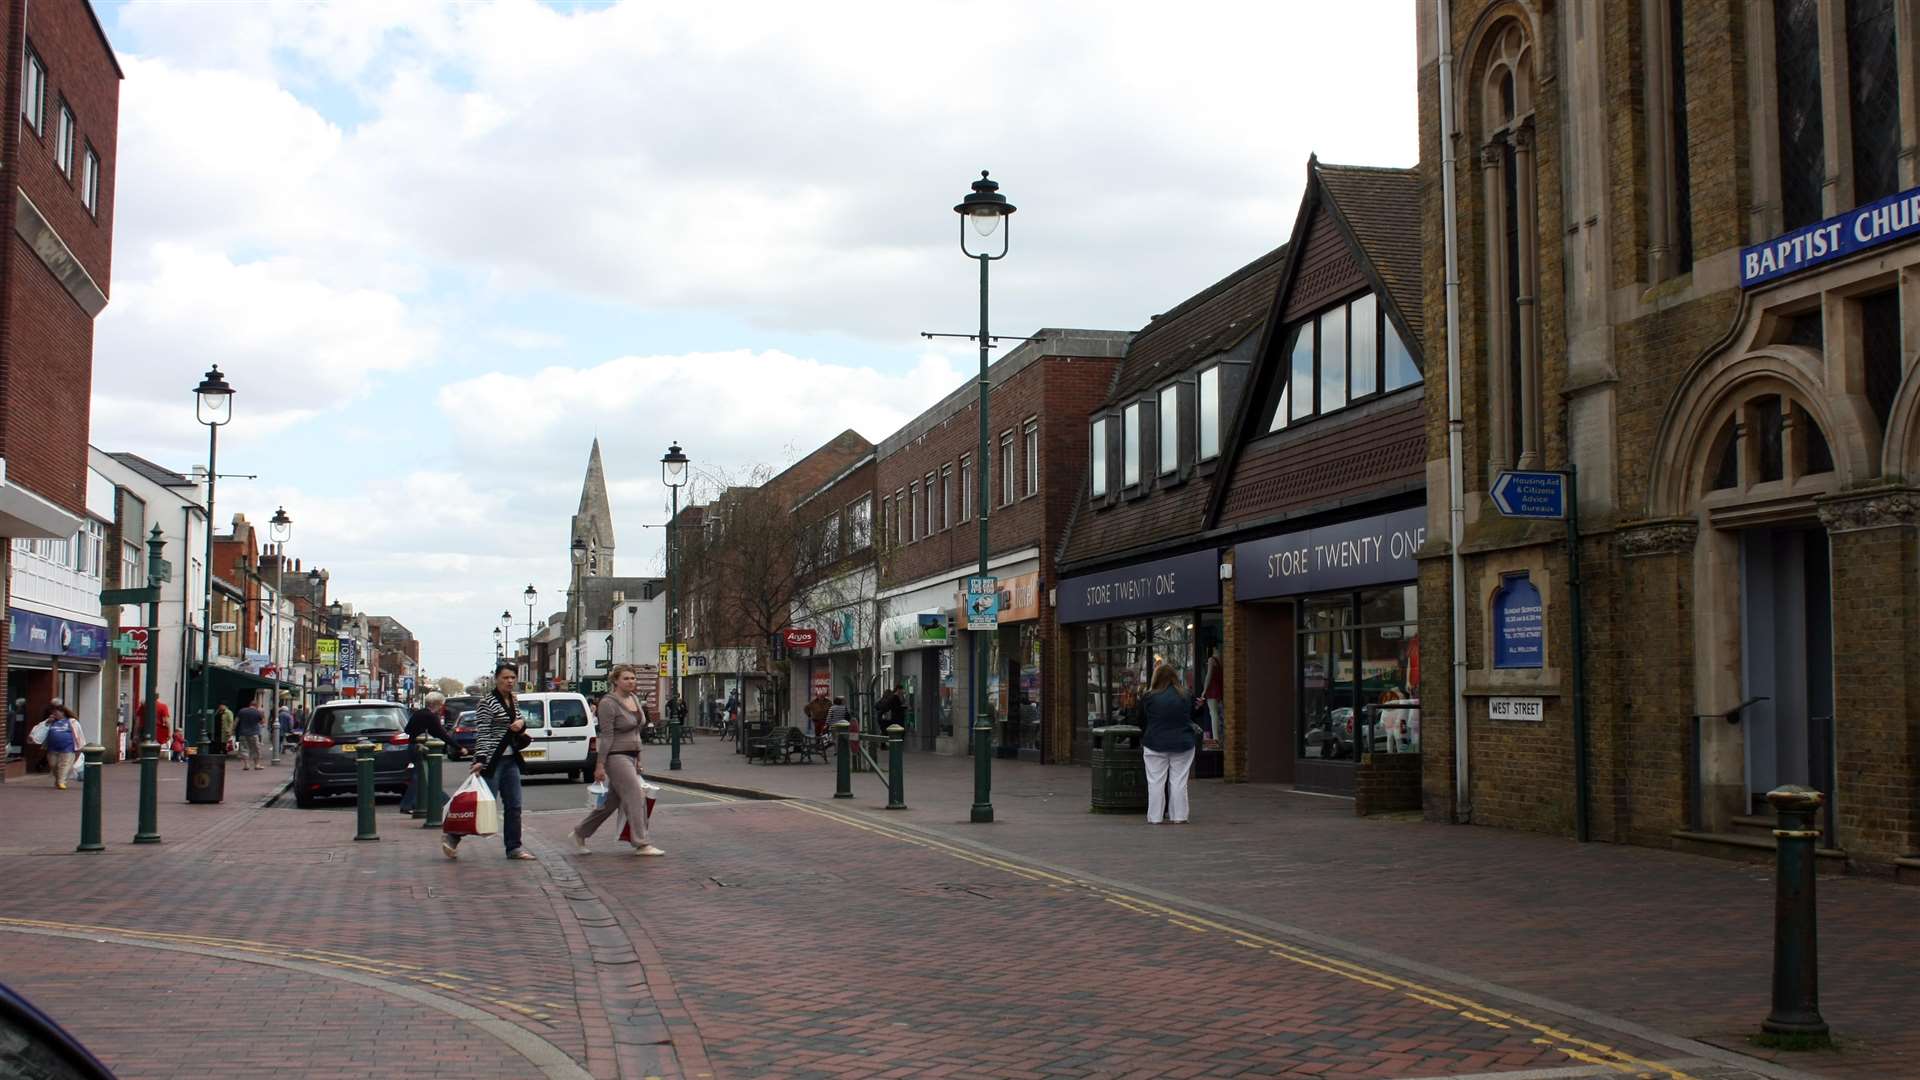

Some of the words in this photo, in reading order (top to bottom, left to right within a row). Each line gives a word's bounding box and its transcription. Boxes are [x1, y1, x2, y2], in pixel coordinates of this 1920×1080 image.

[1745, 222, 1842, 280] BAPTIST
[1268, 548, 1309, 579] STORE
[1315, 535, 1383, 571] TWENTY
[1087, 584, 1111, 606] STORE
[1114, 576, 1151, 602] TWENTY
[1156, 572, 1176, 596] ONE
[787, 632, 812, 641] Argos
[1491, 702, 1511, 714] WEST
[1514, 702, 1540, 715] STREET
